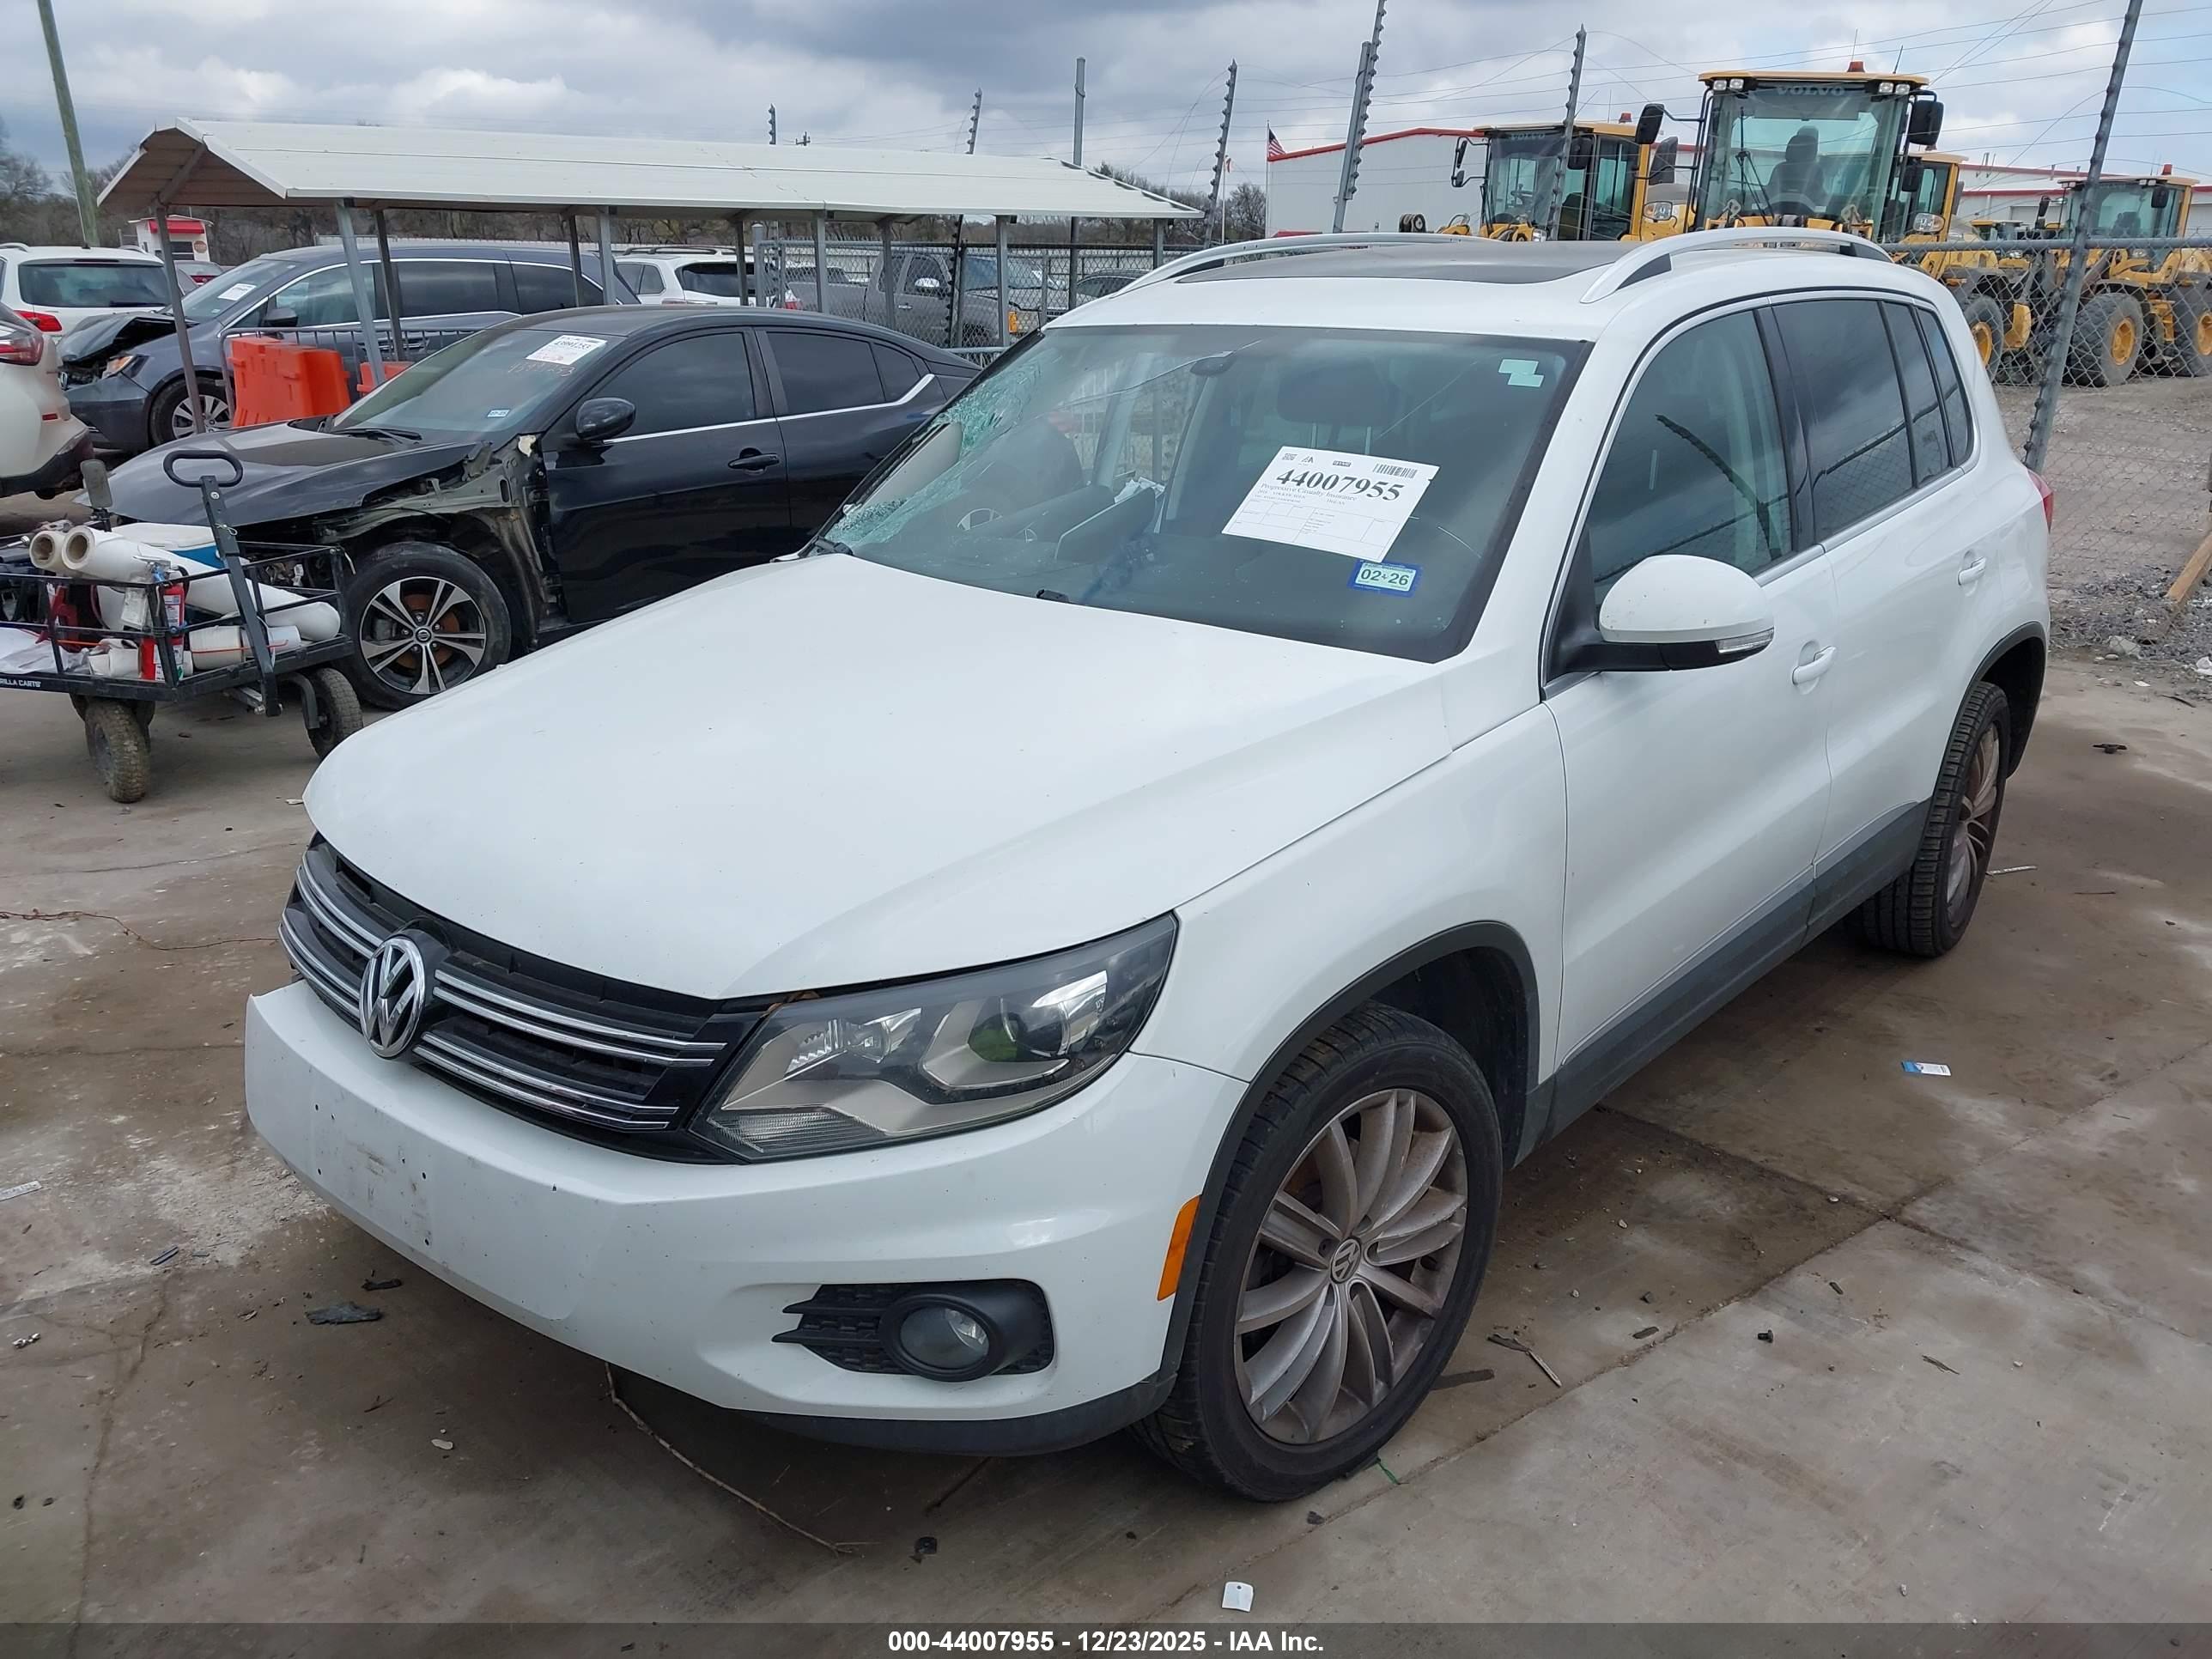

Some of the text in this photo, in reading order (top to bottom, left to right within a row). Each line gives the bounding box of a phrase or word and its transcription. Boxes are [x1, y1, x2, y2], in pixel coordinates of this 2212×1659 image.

[1777, 86, 1844, 95] VOLVO
[1276, 469, 1405, 501] 44007955
[1361, 568, 1382, 581] 02
[1388, 573, 1410, 586] 26
[19, 679, 41, 688] CARTS
